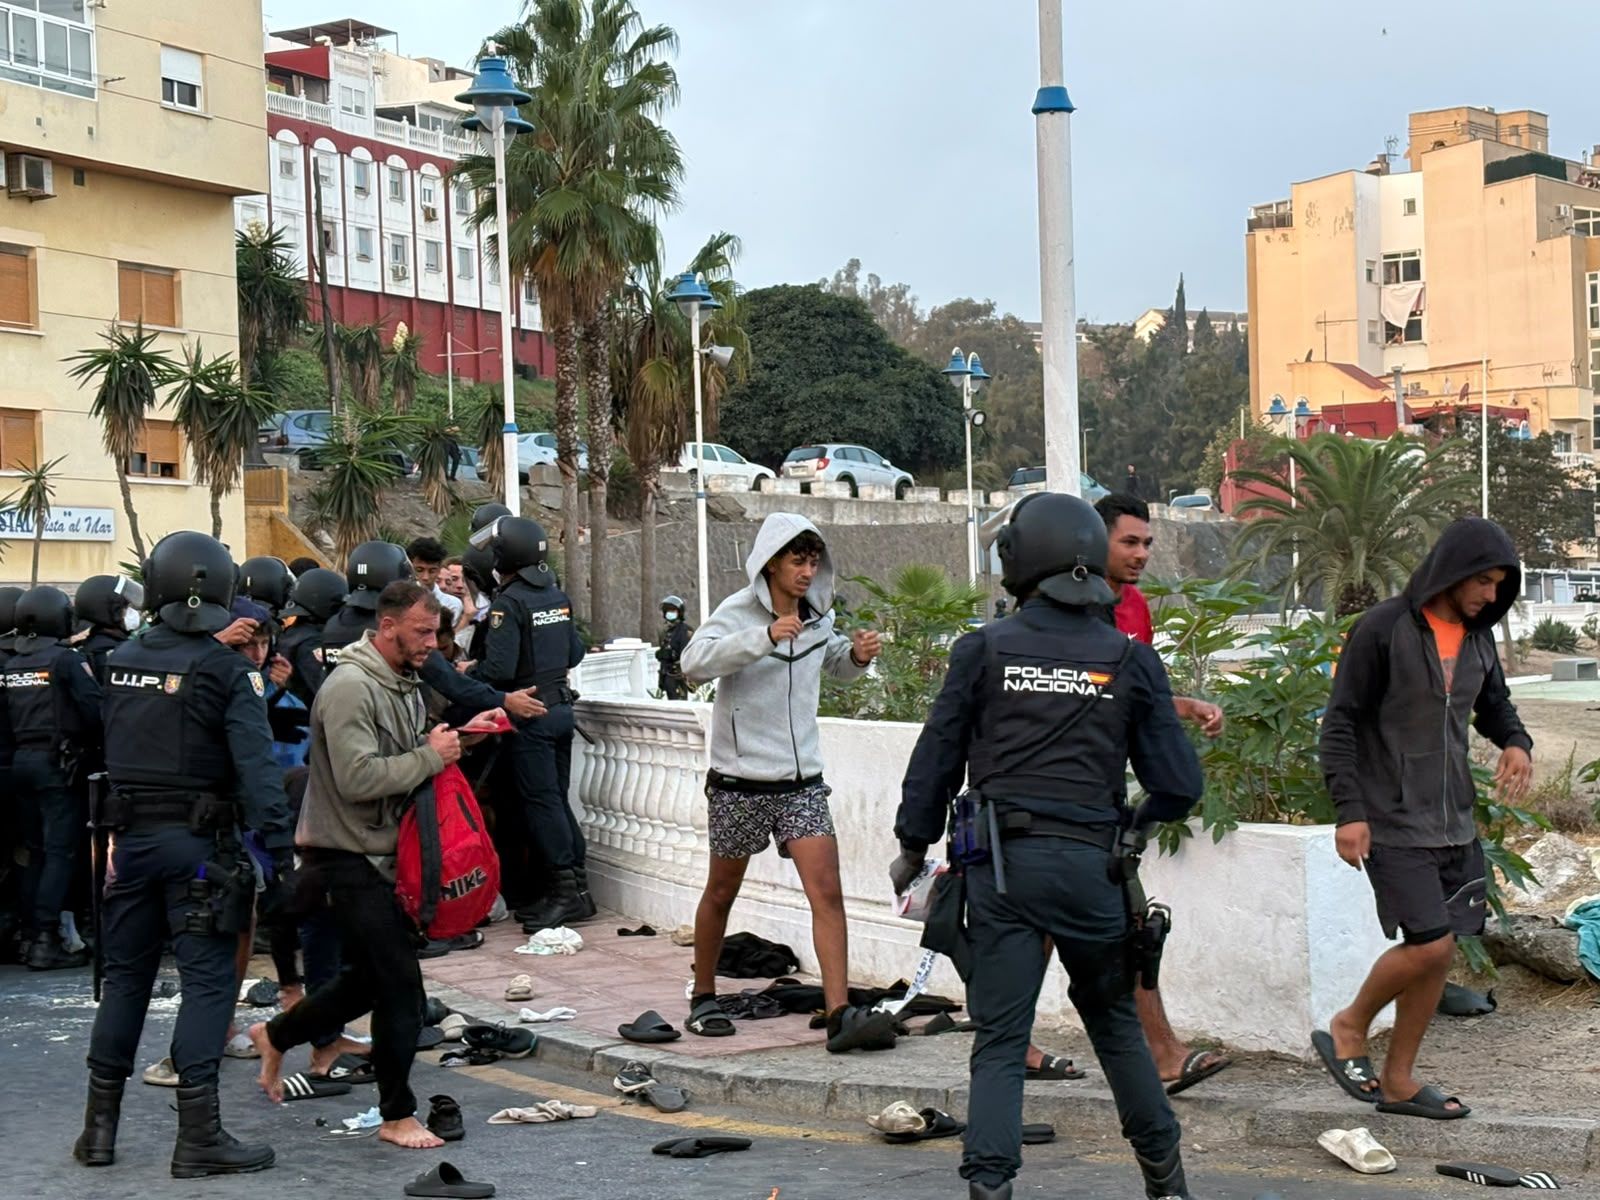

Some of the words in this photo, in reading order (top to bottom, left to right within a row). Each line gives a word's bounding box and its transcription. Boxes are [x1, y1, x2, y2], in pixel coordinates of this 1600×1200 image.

[69, 517, 81, 533] al
[84, 515, 113, 534] Mar
[532, 608, 562, 620] POLICIA
[533, 614, 571, 627] NACIONAL
[6, 672, 40, 681] POLICIA
[111, 672, 163, 690] U.I.P.
[1004, 666, 1093, 683] POLICIA
[6, 678, 50, 688] NACIONAL
[440, 866, 488, 901] NIKE
